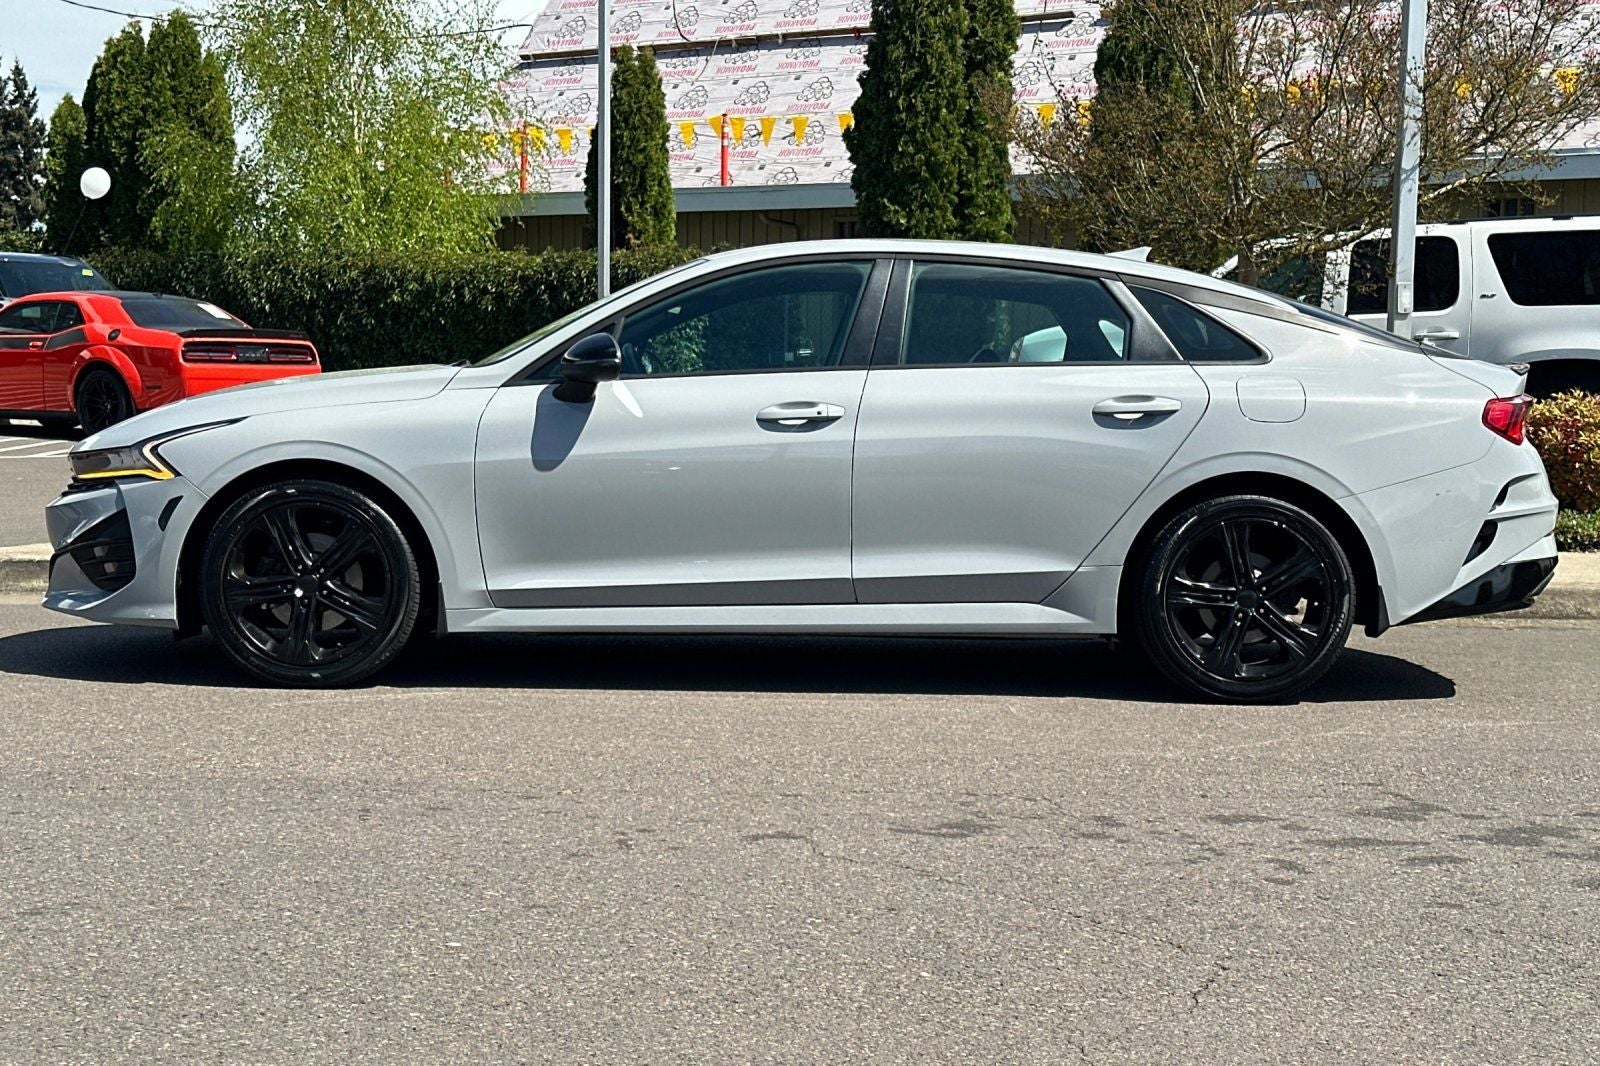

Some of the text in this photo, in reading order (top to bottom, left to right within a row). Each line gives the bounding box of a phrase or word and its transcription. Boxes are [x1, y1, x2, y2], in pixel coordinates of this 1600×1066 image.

[714, 23, 756, 33] PROARMOR
[1047, 38, 1096, 48] PROARMOR
[715, 64, 757, 74] PROARMOR
[777, 60, 819, 69] PROARMOR
